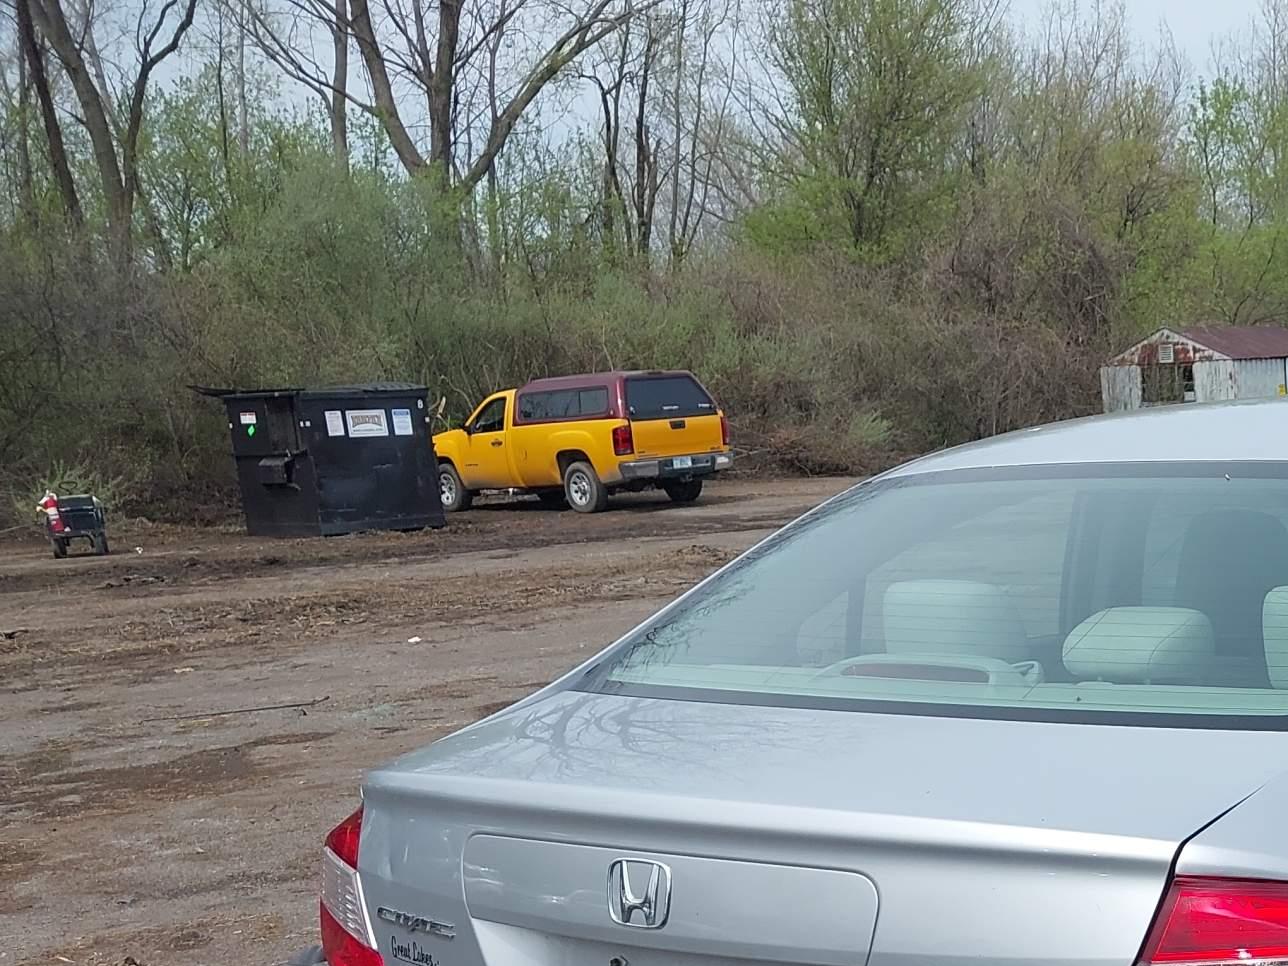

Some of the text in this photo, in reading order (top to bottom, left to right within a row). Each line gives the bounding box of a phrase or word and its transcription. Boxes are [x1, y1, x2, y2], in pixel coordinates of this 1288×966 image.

[377, 905, 456, 939] CIVIC
[391, 935, 434, 966] Great Lakes
